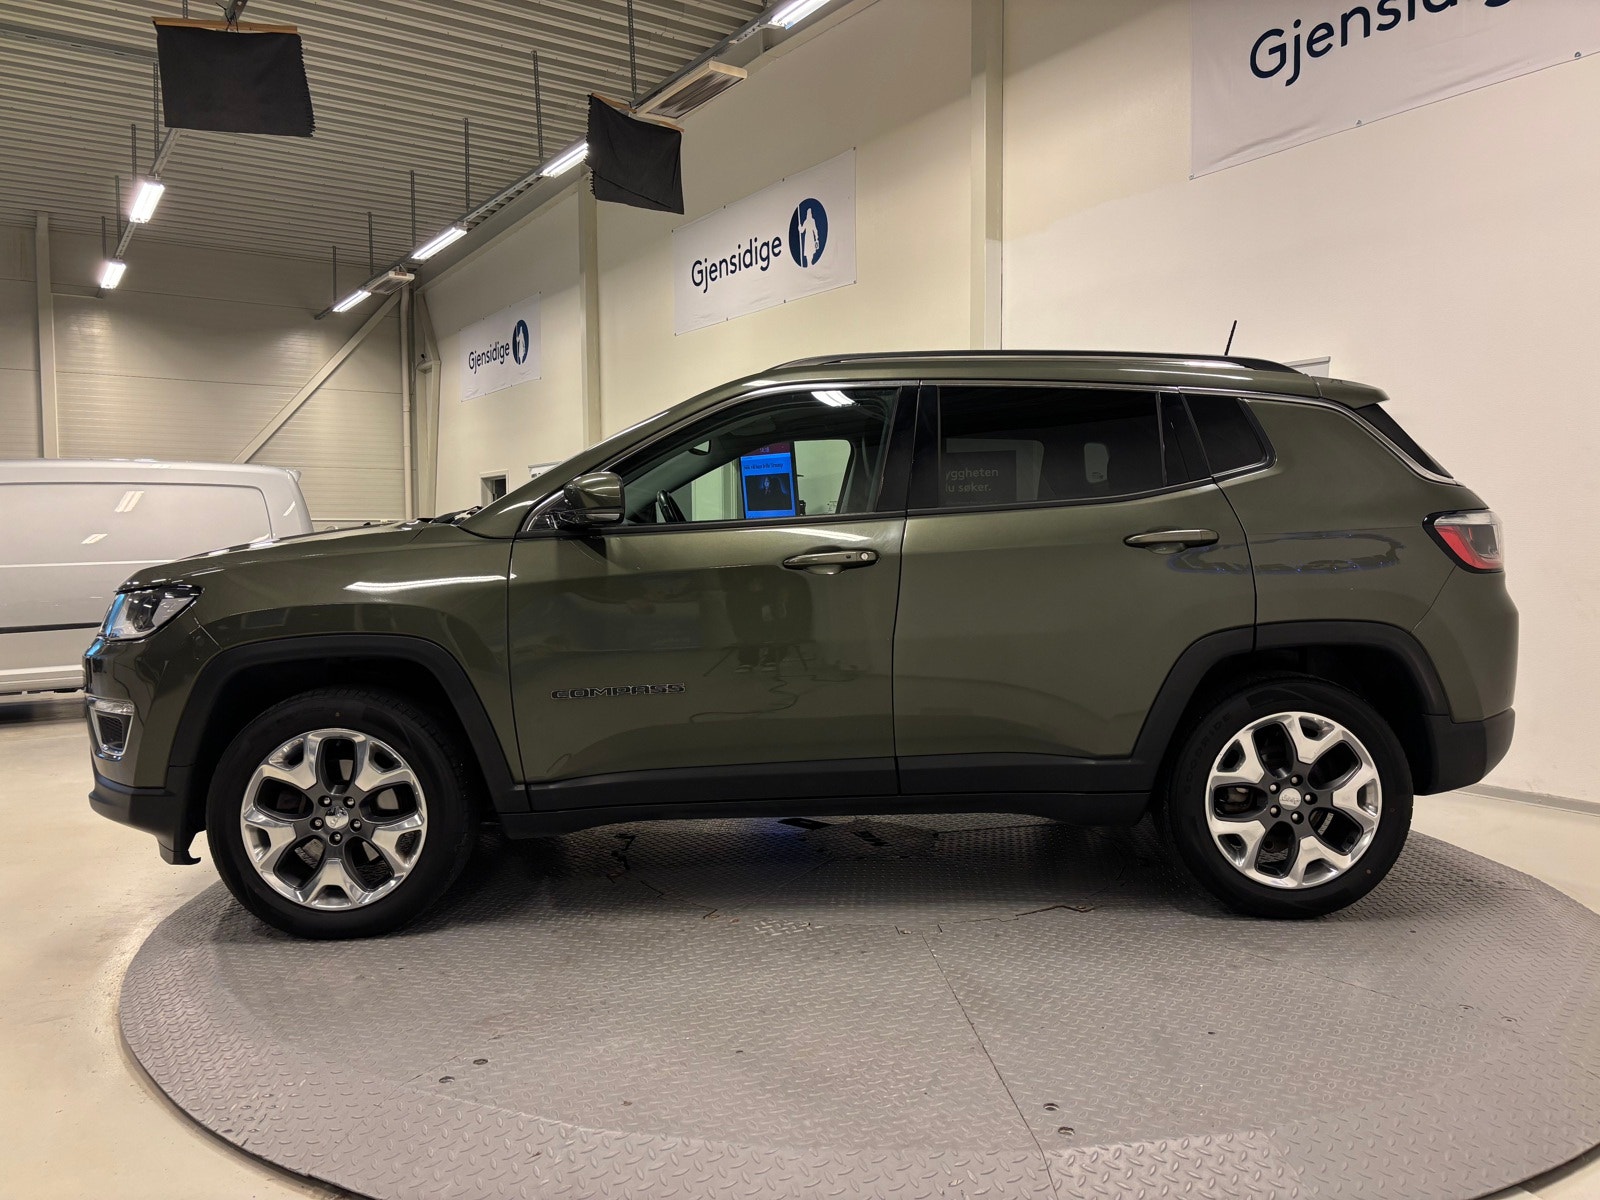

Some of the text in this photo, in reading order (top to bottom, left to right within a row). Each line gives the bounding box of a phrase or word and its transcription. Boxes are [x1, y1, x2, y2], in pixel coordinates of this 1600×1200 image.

[691, 236, 782, 293] Gjensidige
[468, 341, 510, 374] Gjensidige
[958, 482, 992, 492] søker.
[551, 682, 686, 699] COMPASS
